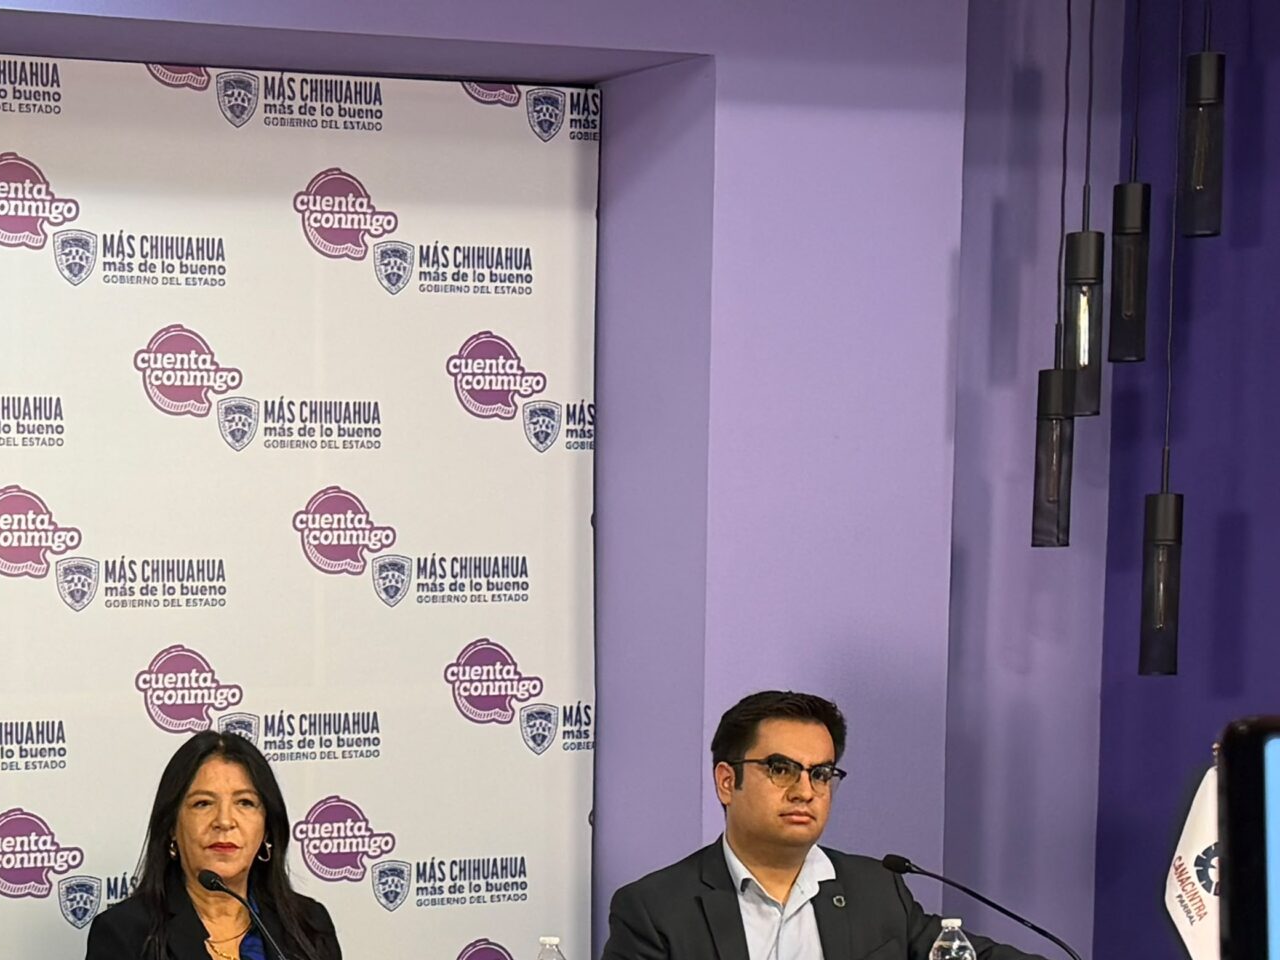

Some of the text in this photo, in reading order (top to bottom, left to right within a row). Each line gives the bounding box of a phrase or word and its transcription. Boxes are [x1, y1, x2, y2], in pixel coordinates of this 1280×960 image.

[419, 242, 533, 271] MÁS CHIHUAHUA
[418, 269, 533, 284] más de lo bueno
[418, 283, 532, 295] GOBIERNO DEL ESTADO
[449, 356, 518, 374] cuenta
[462, 371, 544, 394] conmigo
[16, 421, 65, 435] bueno
[21, 437, 64, 447] ESTADO
[295, 510, 367, 529] cuenta
[309, 525, 394, 549] conmigo
[104, 555, 226, 584] MÁS CHIHUAHUA
[104, 583, 227, 597] más de lo bueno
[104, 598, 226, 608] GOBIERNO DEL ESTADO
[446, 662, 515, 681] cuenta
[460, 676, 540, 698] conmigo
[0, 746, 15, 760] lo
[18, 745, 67, 759] bueno
[1, 761, 22, 771] DEL
[24, 760, 66, 770] ESTADO
[416, 856, 527, 884] MÁS CHIHUAHUA
[416, 880, 528, 897] más de lo bueno
[1173, 855, 1208, 921] CANACINTRA
[416, 893, 528, 907] GOBIERNO DEL ESTADO
[1176, 893, 1196, 926] PARRAL
